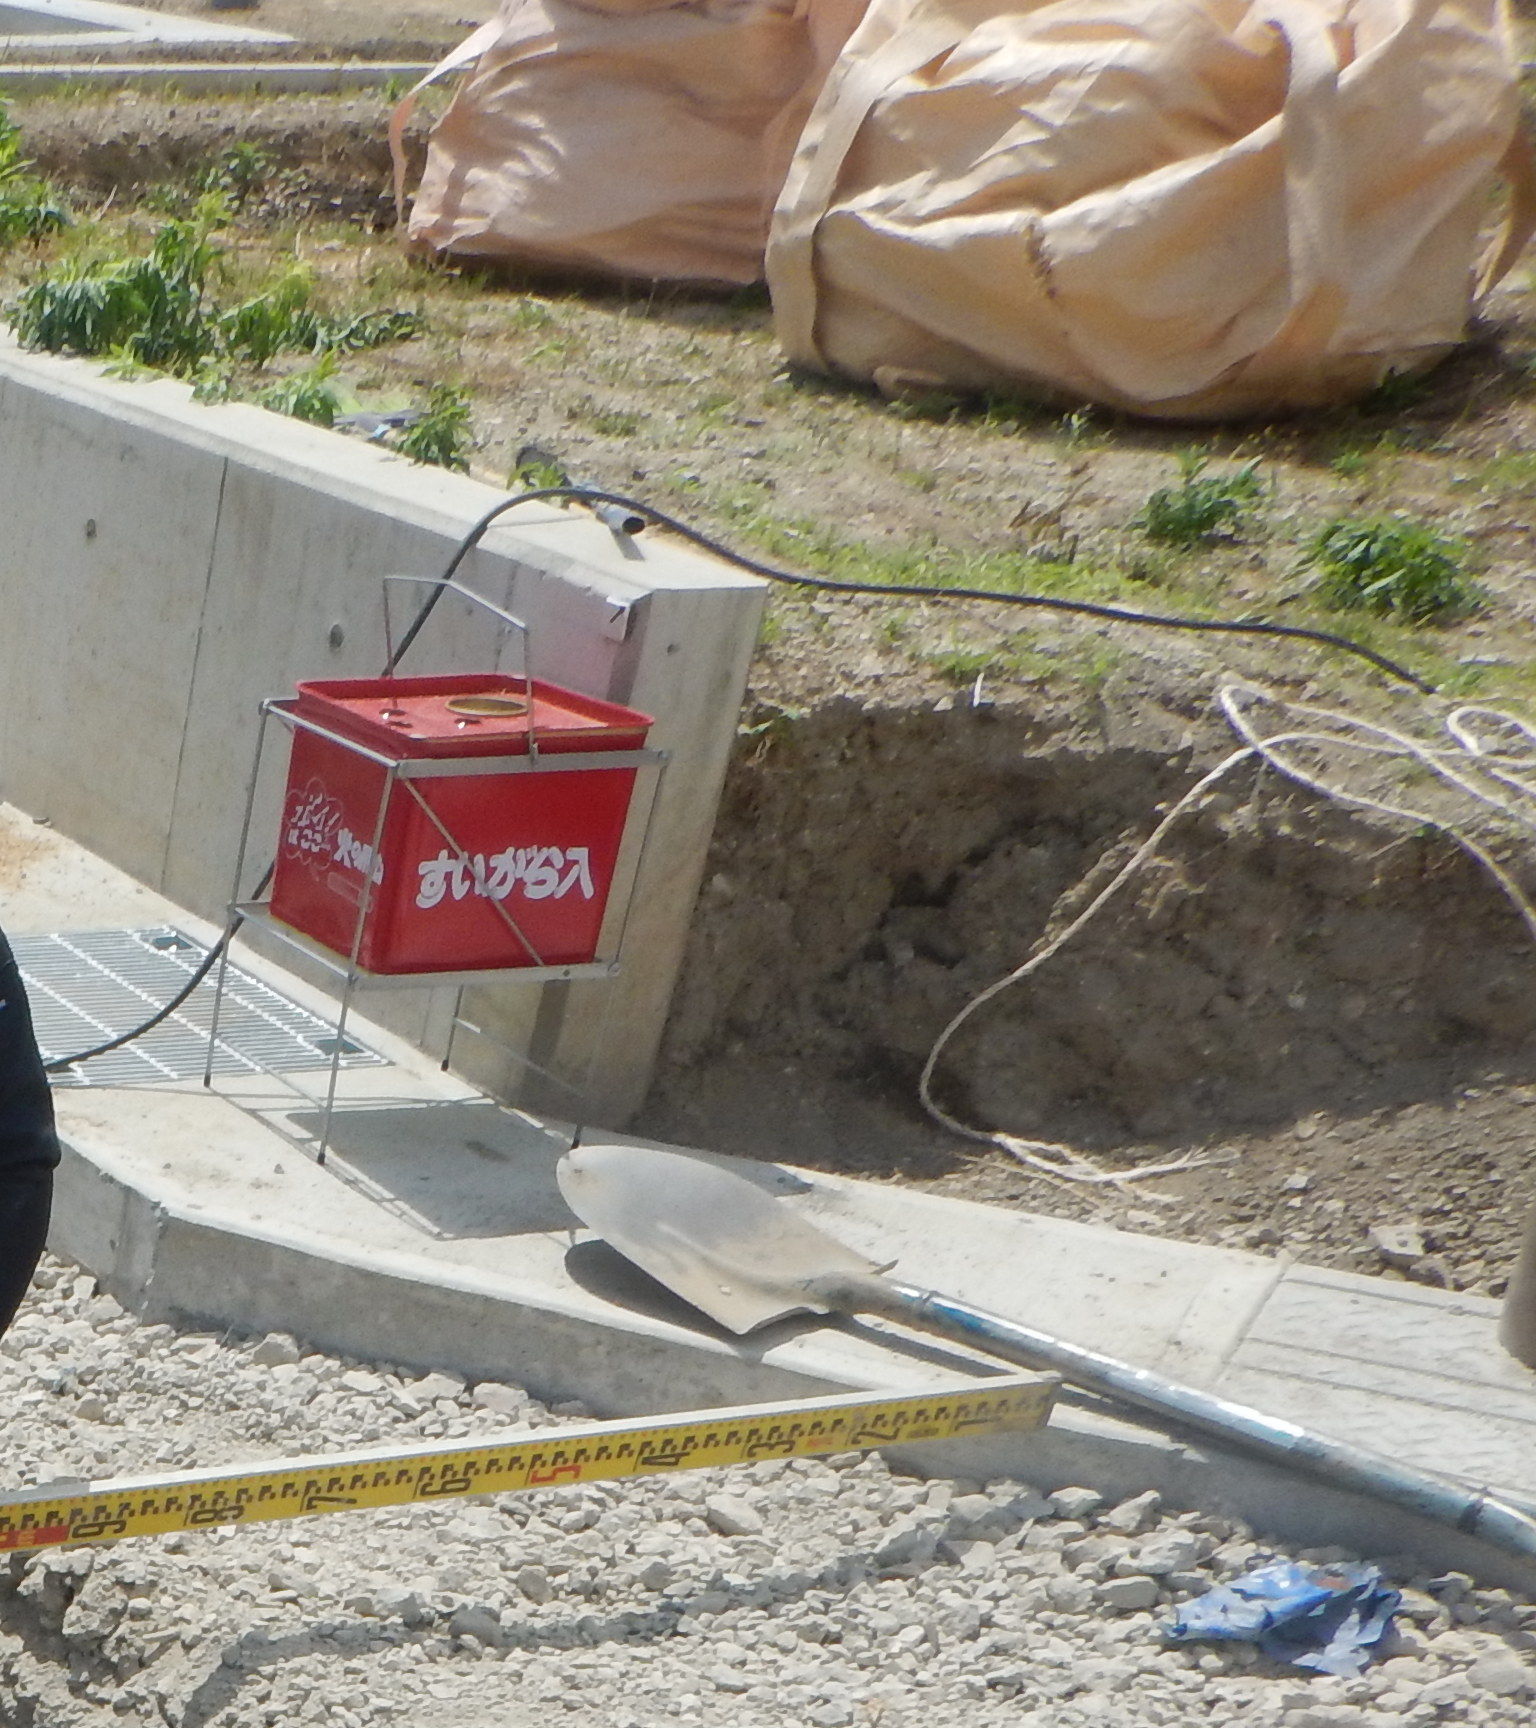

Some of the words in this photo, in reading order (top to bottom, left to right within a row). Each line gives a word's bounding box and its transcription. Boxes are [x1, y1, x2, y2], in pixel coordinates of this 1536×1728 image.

[415, 845, 594, 909] すいがら入
